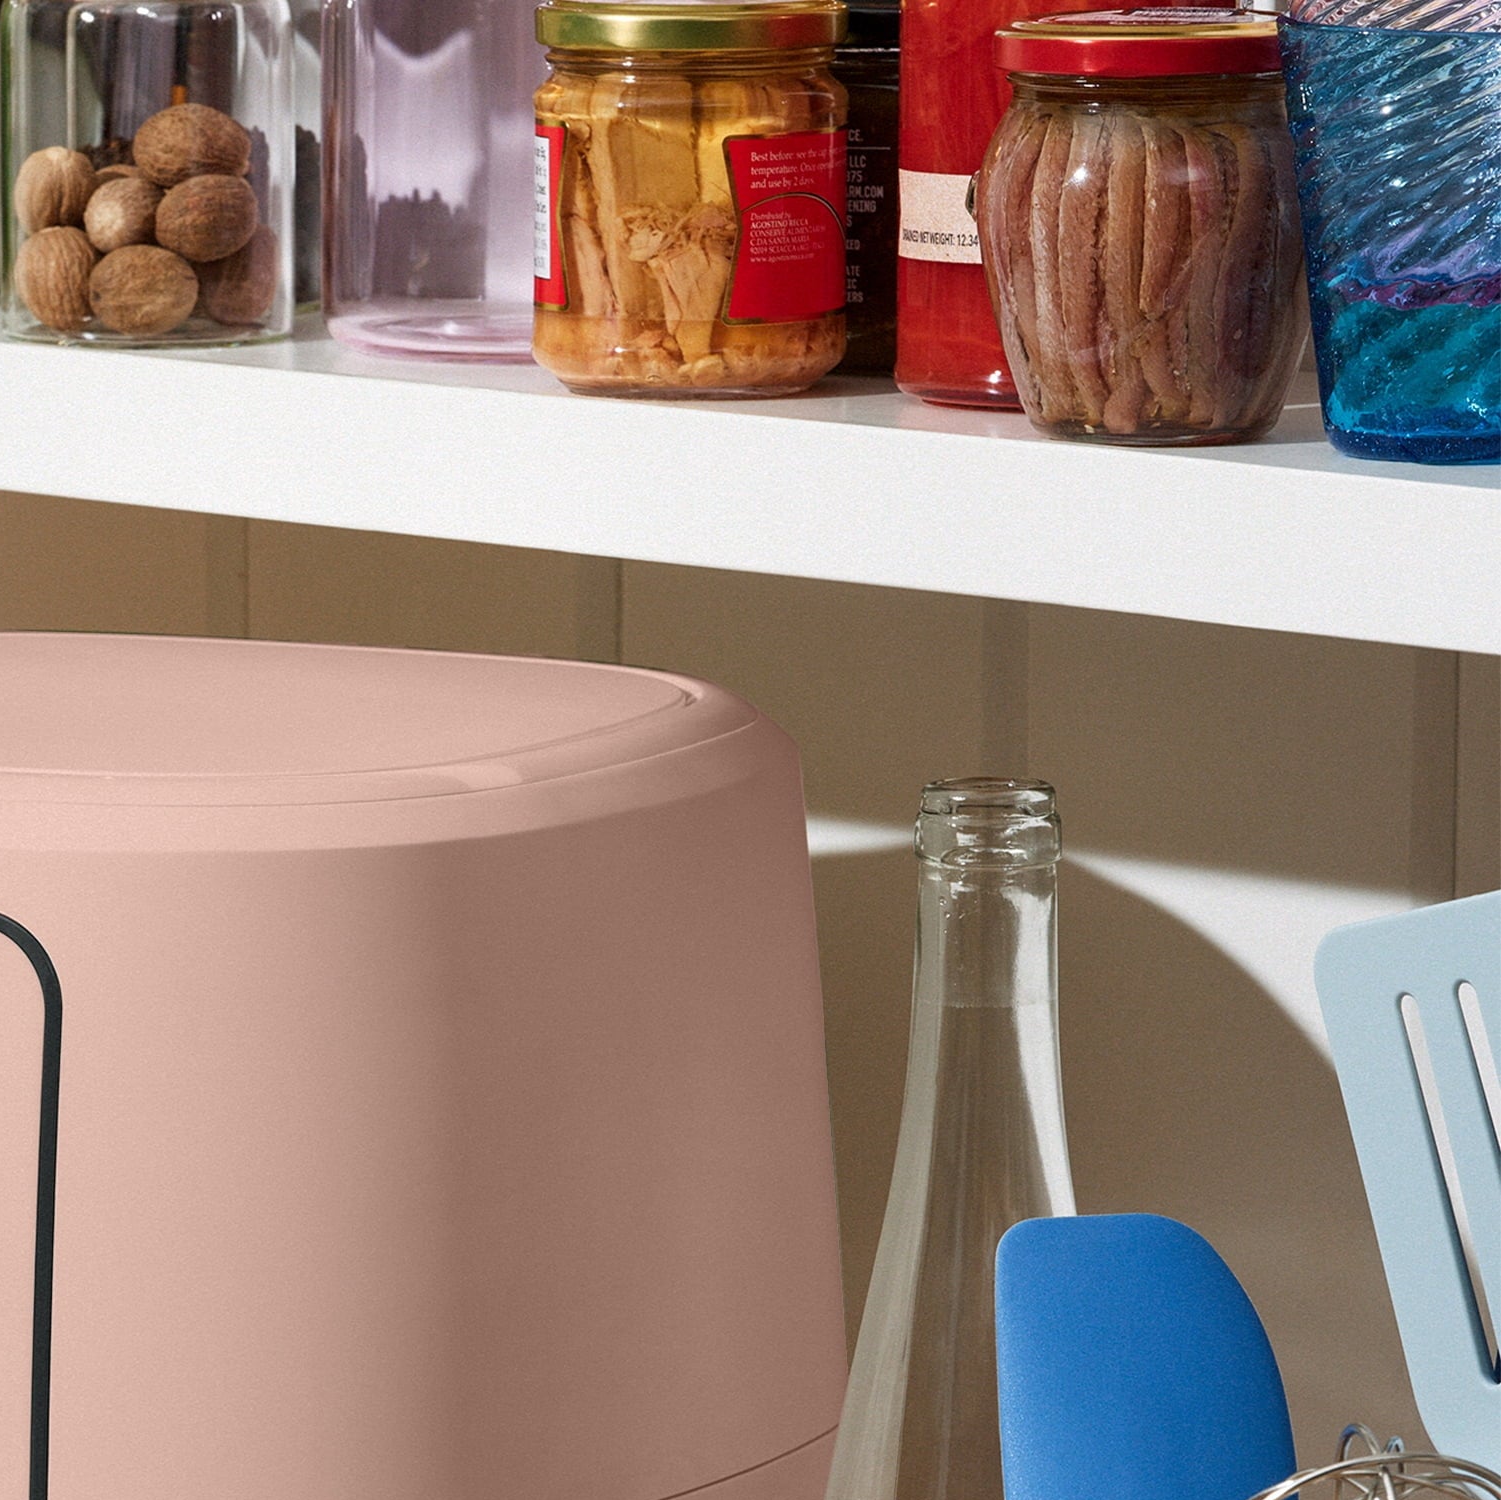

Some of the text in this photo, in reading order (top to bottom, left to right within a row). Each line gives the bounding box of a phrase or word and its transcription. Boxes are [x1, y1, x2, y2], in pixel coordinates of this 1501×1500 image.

[750, 151, 768, 162] Best
[750, 177, 768, 189] and
[768, 179, 782, 188] use
[750, 219, 788, 229] AGOSTINO
[920, 231, 929, 244] NET
